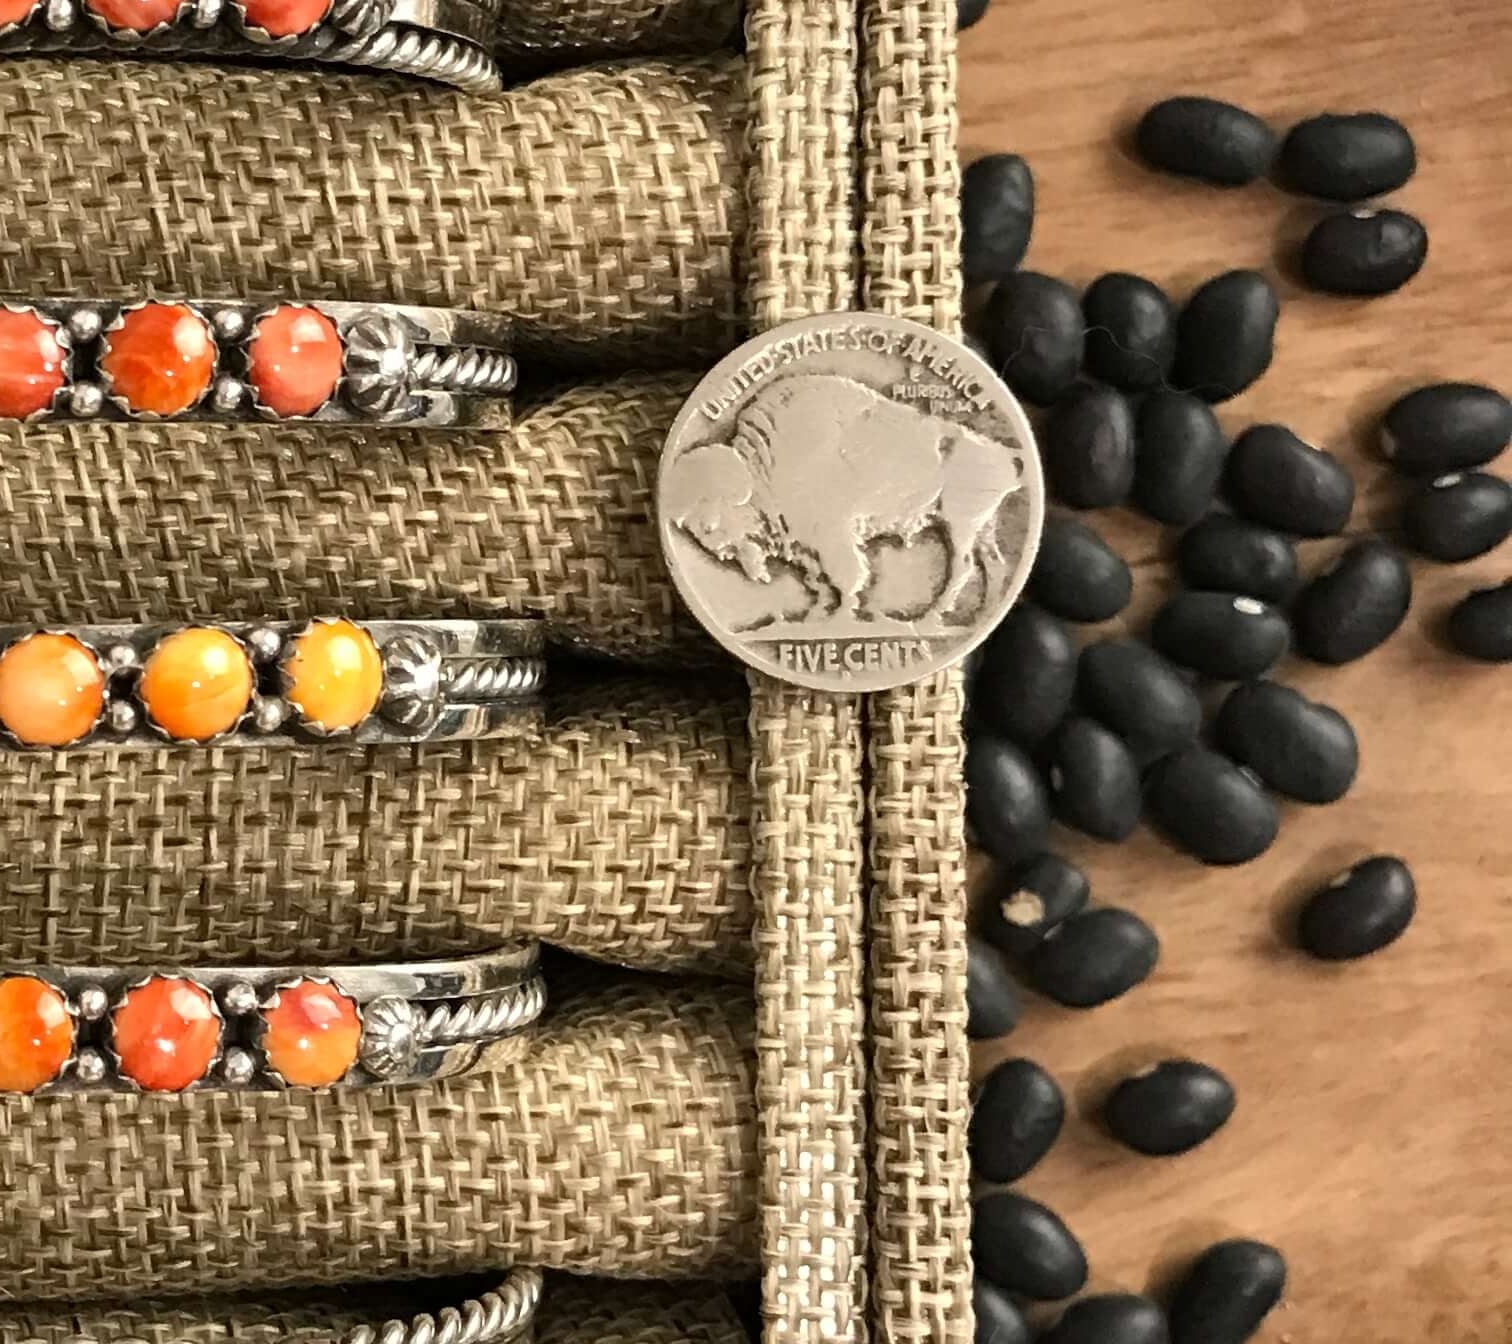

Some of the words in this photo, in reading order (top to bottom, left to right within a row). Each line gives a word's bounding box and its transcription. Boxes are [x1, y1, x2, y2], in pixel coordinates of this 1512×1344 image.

[700, 344, 776, 420] UNITED
[775, 324, 862, 365] STATES
[902, 336, 992, 411] AMERICA
[778, 641, 840, 674] FIVE
